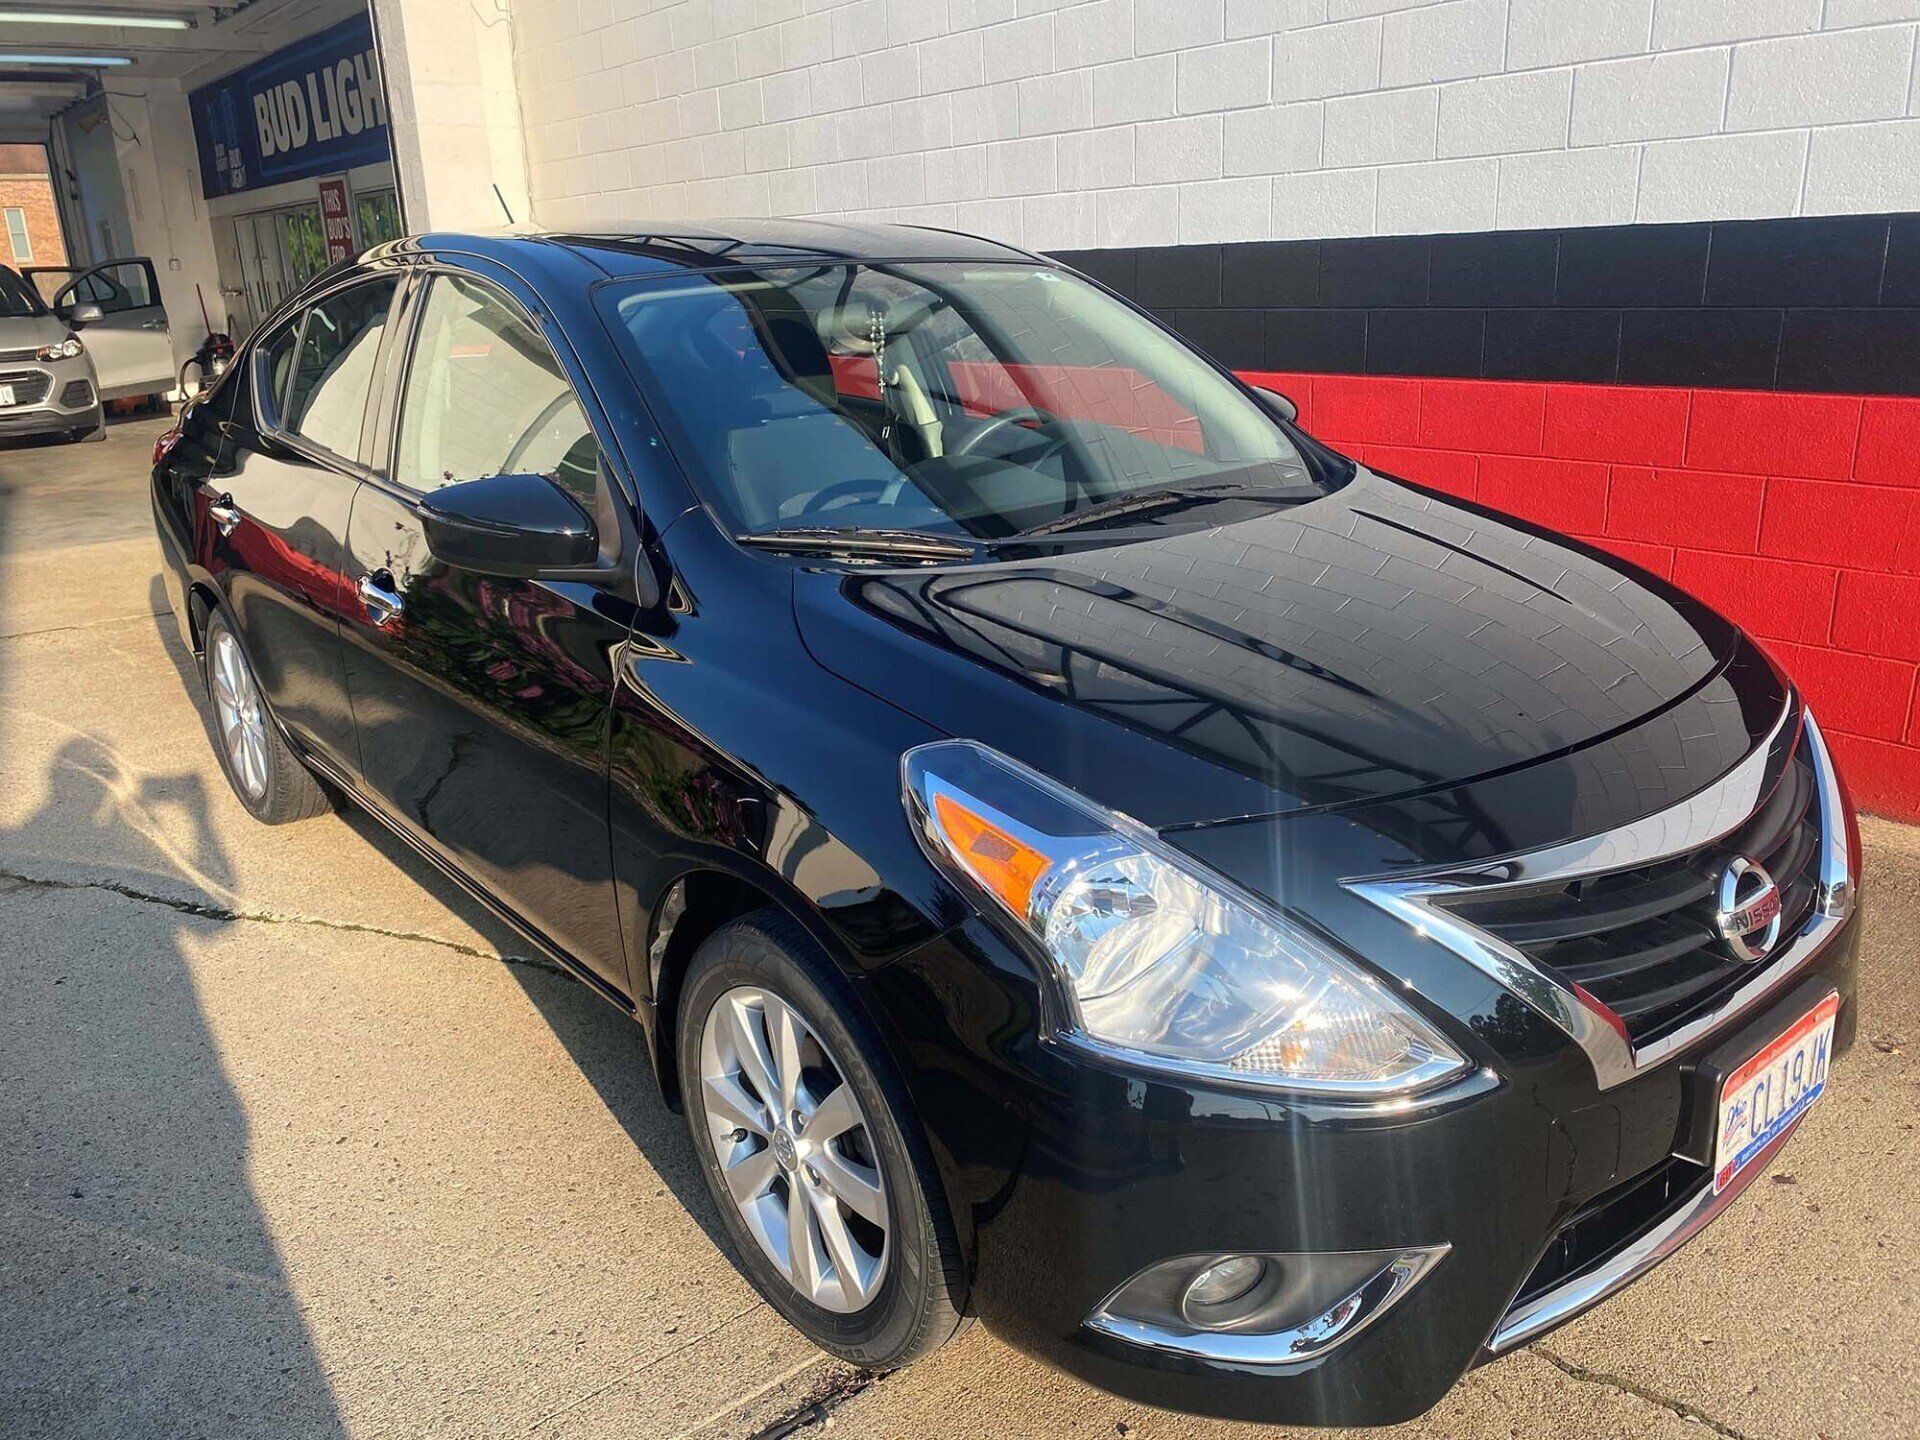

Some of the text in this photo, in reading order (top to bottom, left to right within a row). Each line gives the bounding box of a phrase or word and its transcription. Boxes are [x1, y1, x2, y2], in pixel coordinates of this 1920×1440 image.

[253, 79, 308, 157] BUD
[322, 189, 341, 212] THIS
[327, 217, 351, 239] BUD'S
